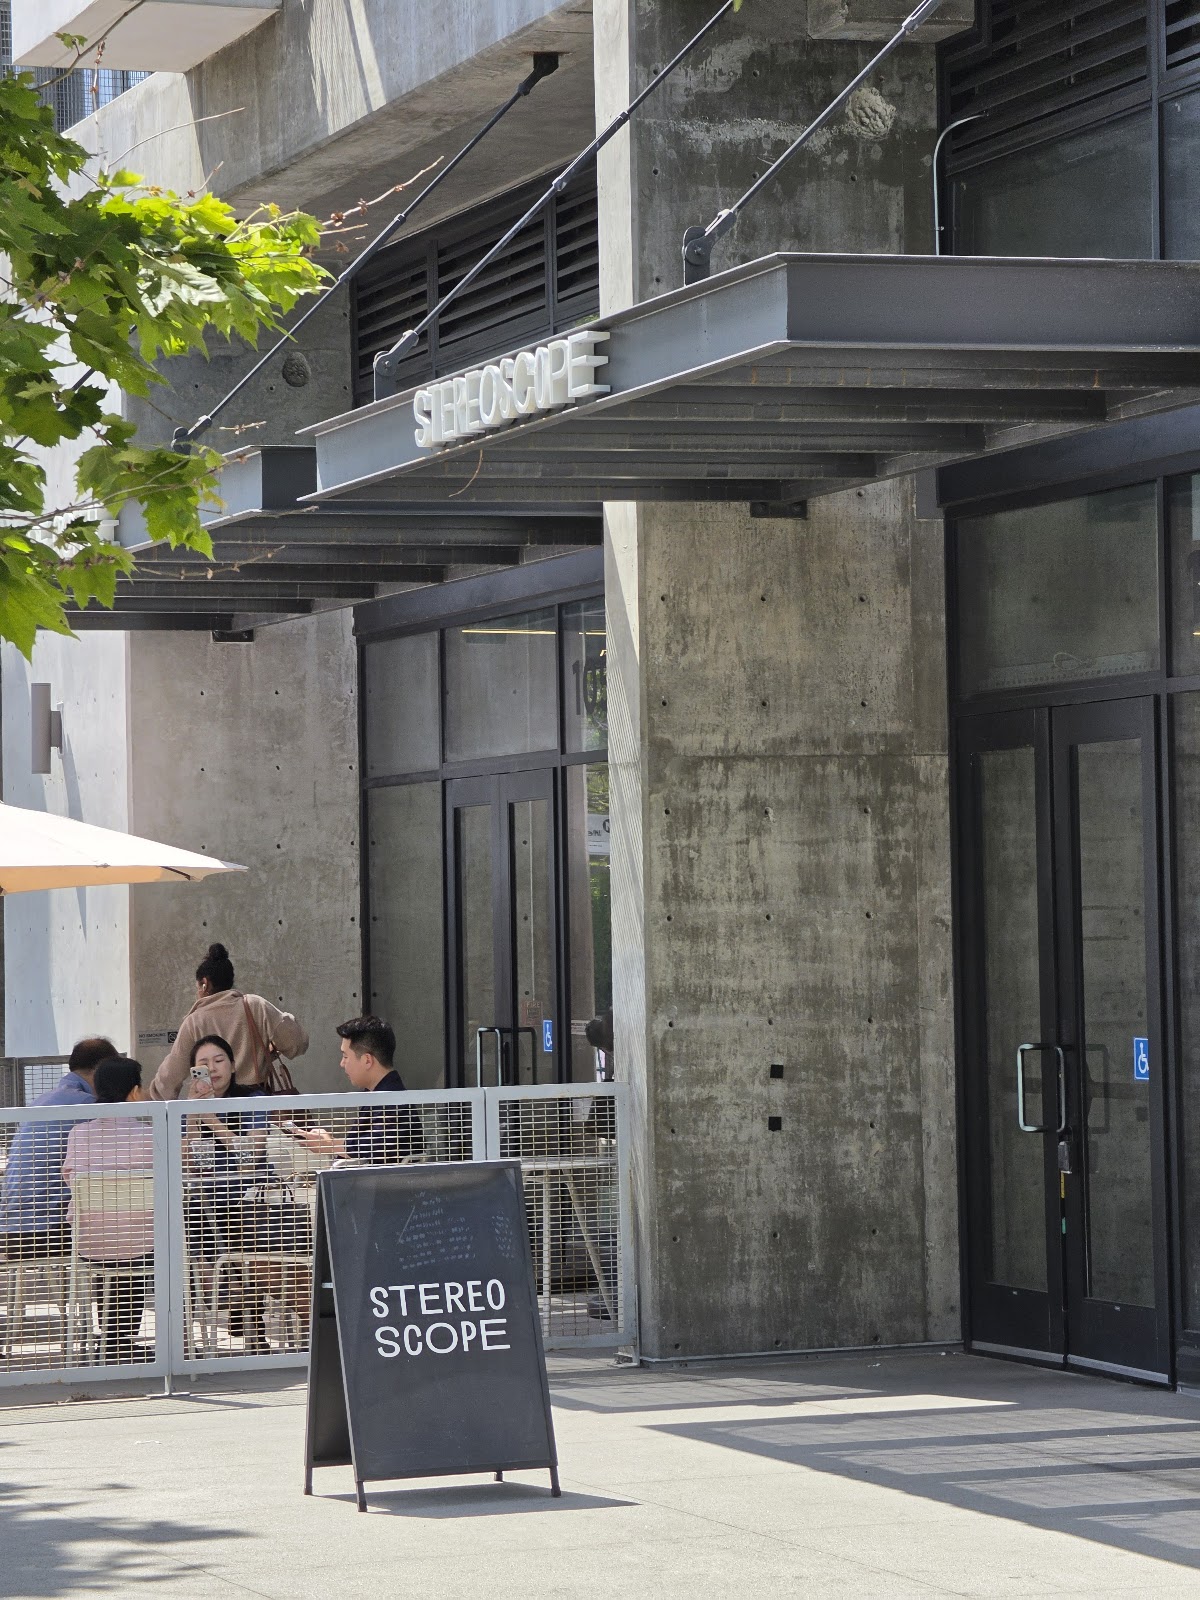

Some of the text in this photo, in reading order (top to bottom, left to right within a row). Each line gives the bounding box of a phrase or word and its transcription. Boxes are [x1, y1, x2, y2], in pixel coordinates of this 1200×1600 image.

[413, 330, 611, 448] STEREOSCOPE
[370, 1279, 505, 1318] STEREO
[375, 1318, 511, 1357] SCOPE
